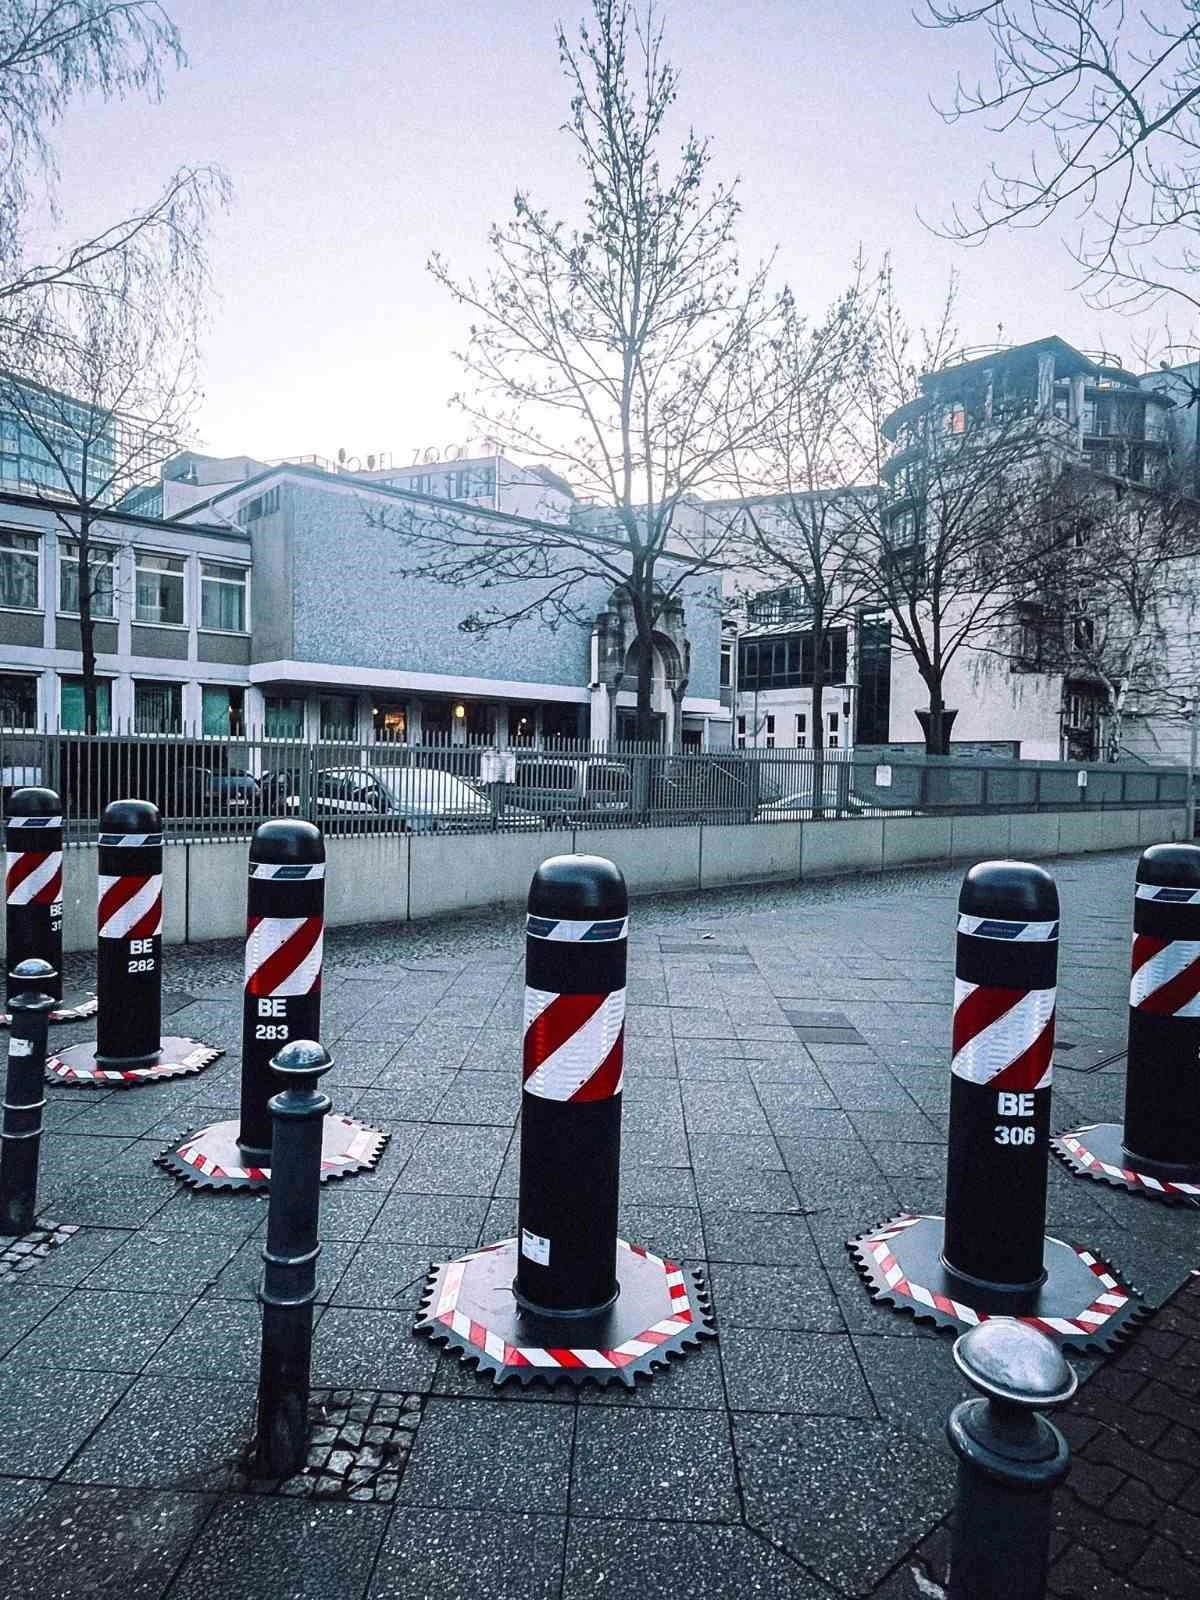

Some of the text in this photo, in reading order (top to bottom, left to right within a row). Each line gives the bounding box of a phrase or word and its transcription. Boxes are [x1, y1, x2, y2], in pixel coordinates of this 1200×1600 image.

[332, 450, 395, 472] OEL
[130, 938, 153, 955] BE
[127, 958, 155, 973] 282
[257, 998, 287, 1017] BE
[255, 1024, 289, 1040] 283
[997, 1092, 1036, 1117] BE
[994, 1125, 1036, 1145] 306
